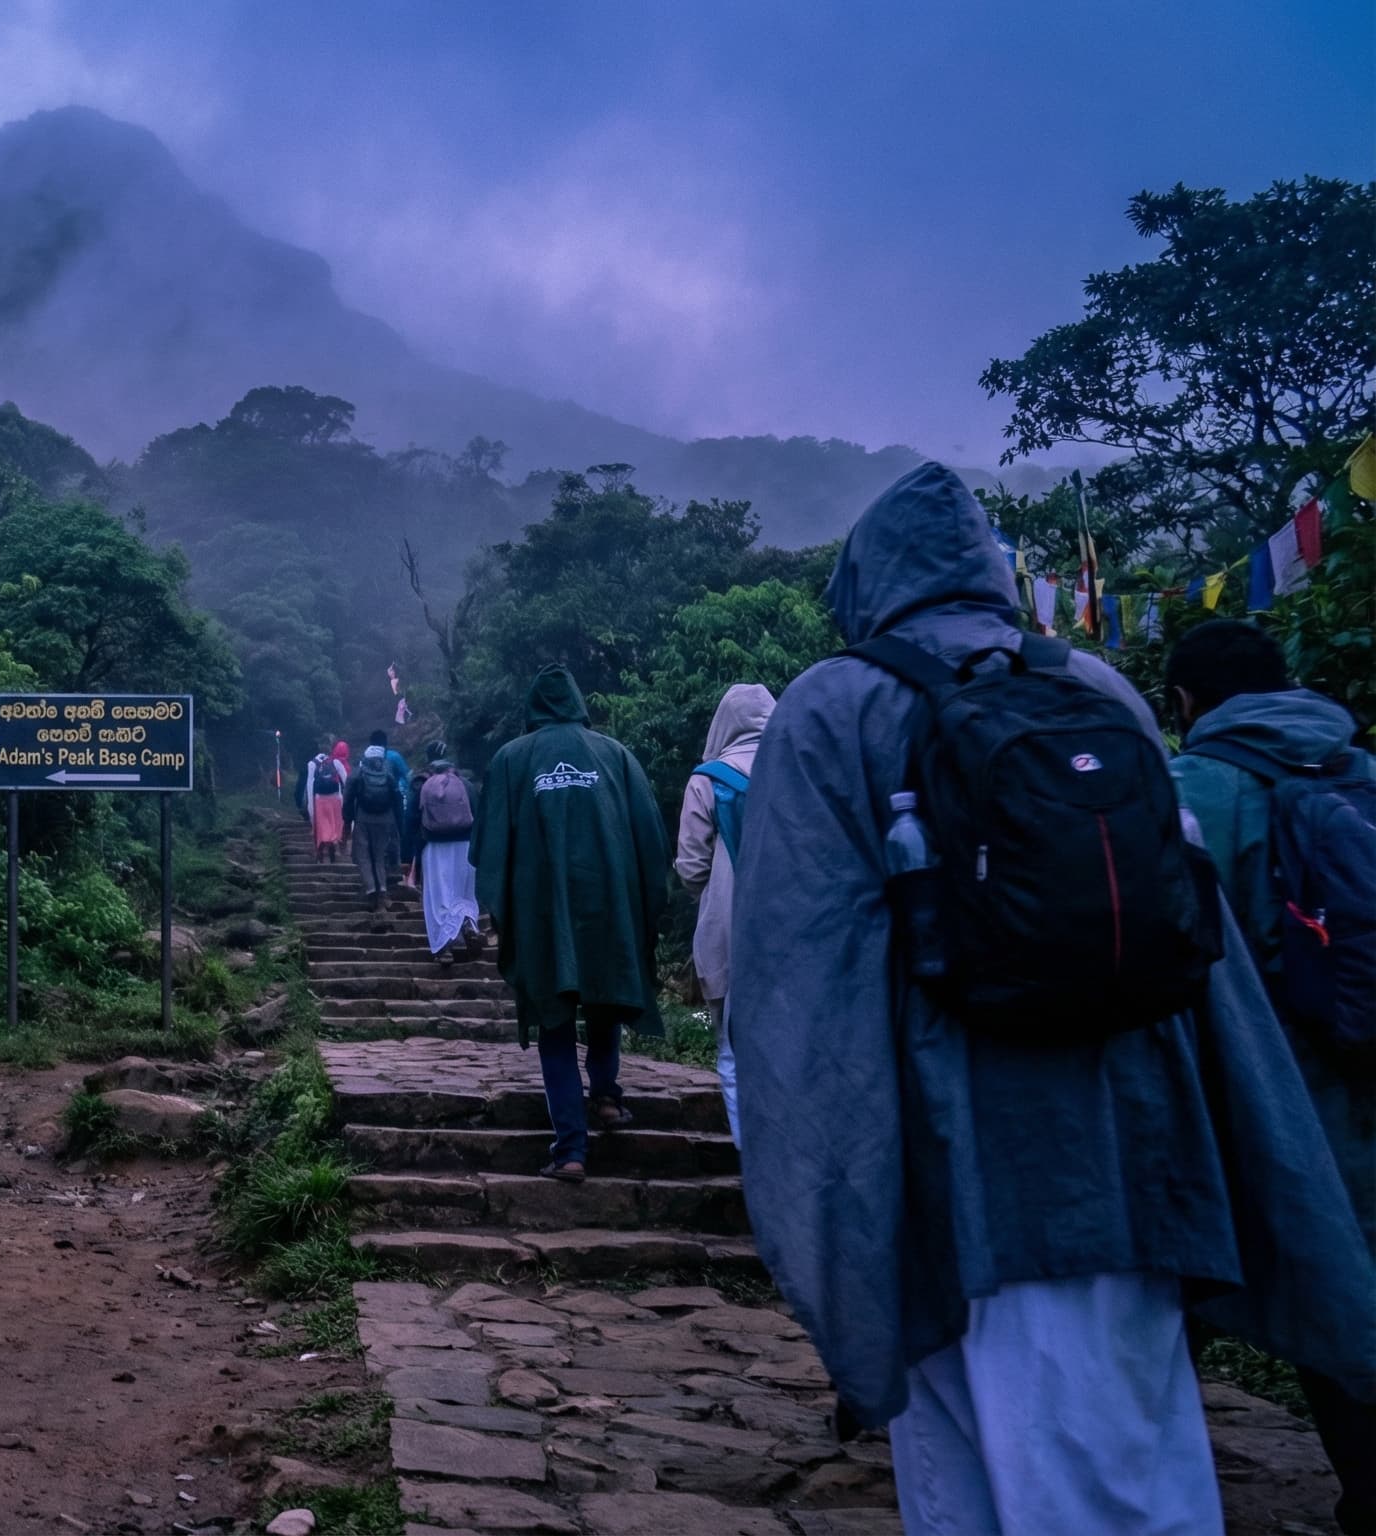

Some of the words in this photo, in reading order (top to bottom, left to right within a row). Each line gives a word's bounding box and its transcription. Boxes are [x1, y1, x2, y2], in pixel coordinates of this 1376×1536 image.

[58, 748, 94, 765] Peak
[99, 749, 136, 765] Base
[141, 749, 184, 770] Camp
